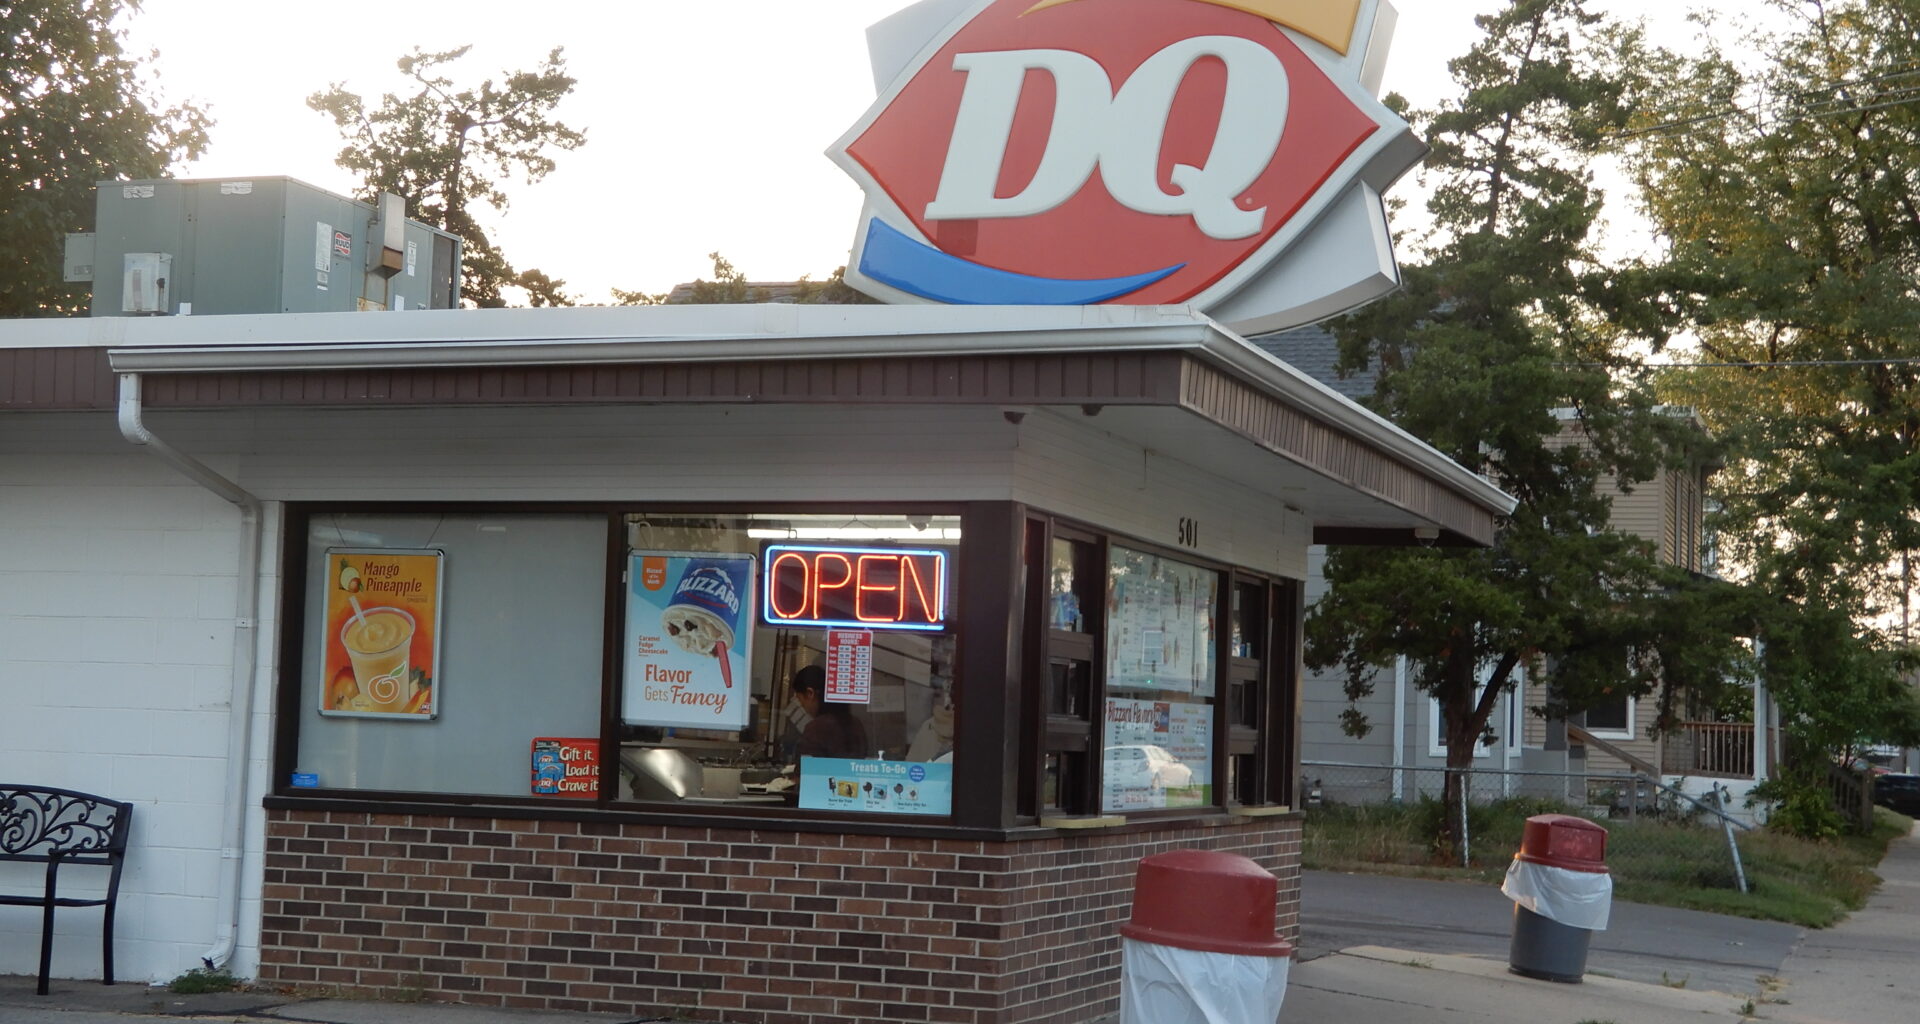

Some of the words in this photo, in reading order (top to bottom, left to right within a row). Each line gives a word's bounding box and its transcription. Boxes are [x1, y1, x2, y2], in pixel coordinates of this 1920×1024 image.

[924, 34, 1290, 240] DQ
[1178, 516, 1198, 549] 501
[364, 561, 400, 579] Mango
[366, 577, 422, 597] Pineapple
[676, 576, 740, 614] BLIZZARD
[771, 552, 942, 623] OPEN
[645, 664, 692, 683] Flavor
[645, 685, 669, 701] Gets
[670, 685, 728, 715] Fancy
[559, 746, 581, 761] Gift
[565, 763, 590, 777] Load
[849, 762, 879, 773] Treats
[880, 763, 907, 775] To-Go
[557, 779, 588, 792] Crave
